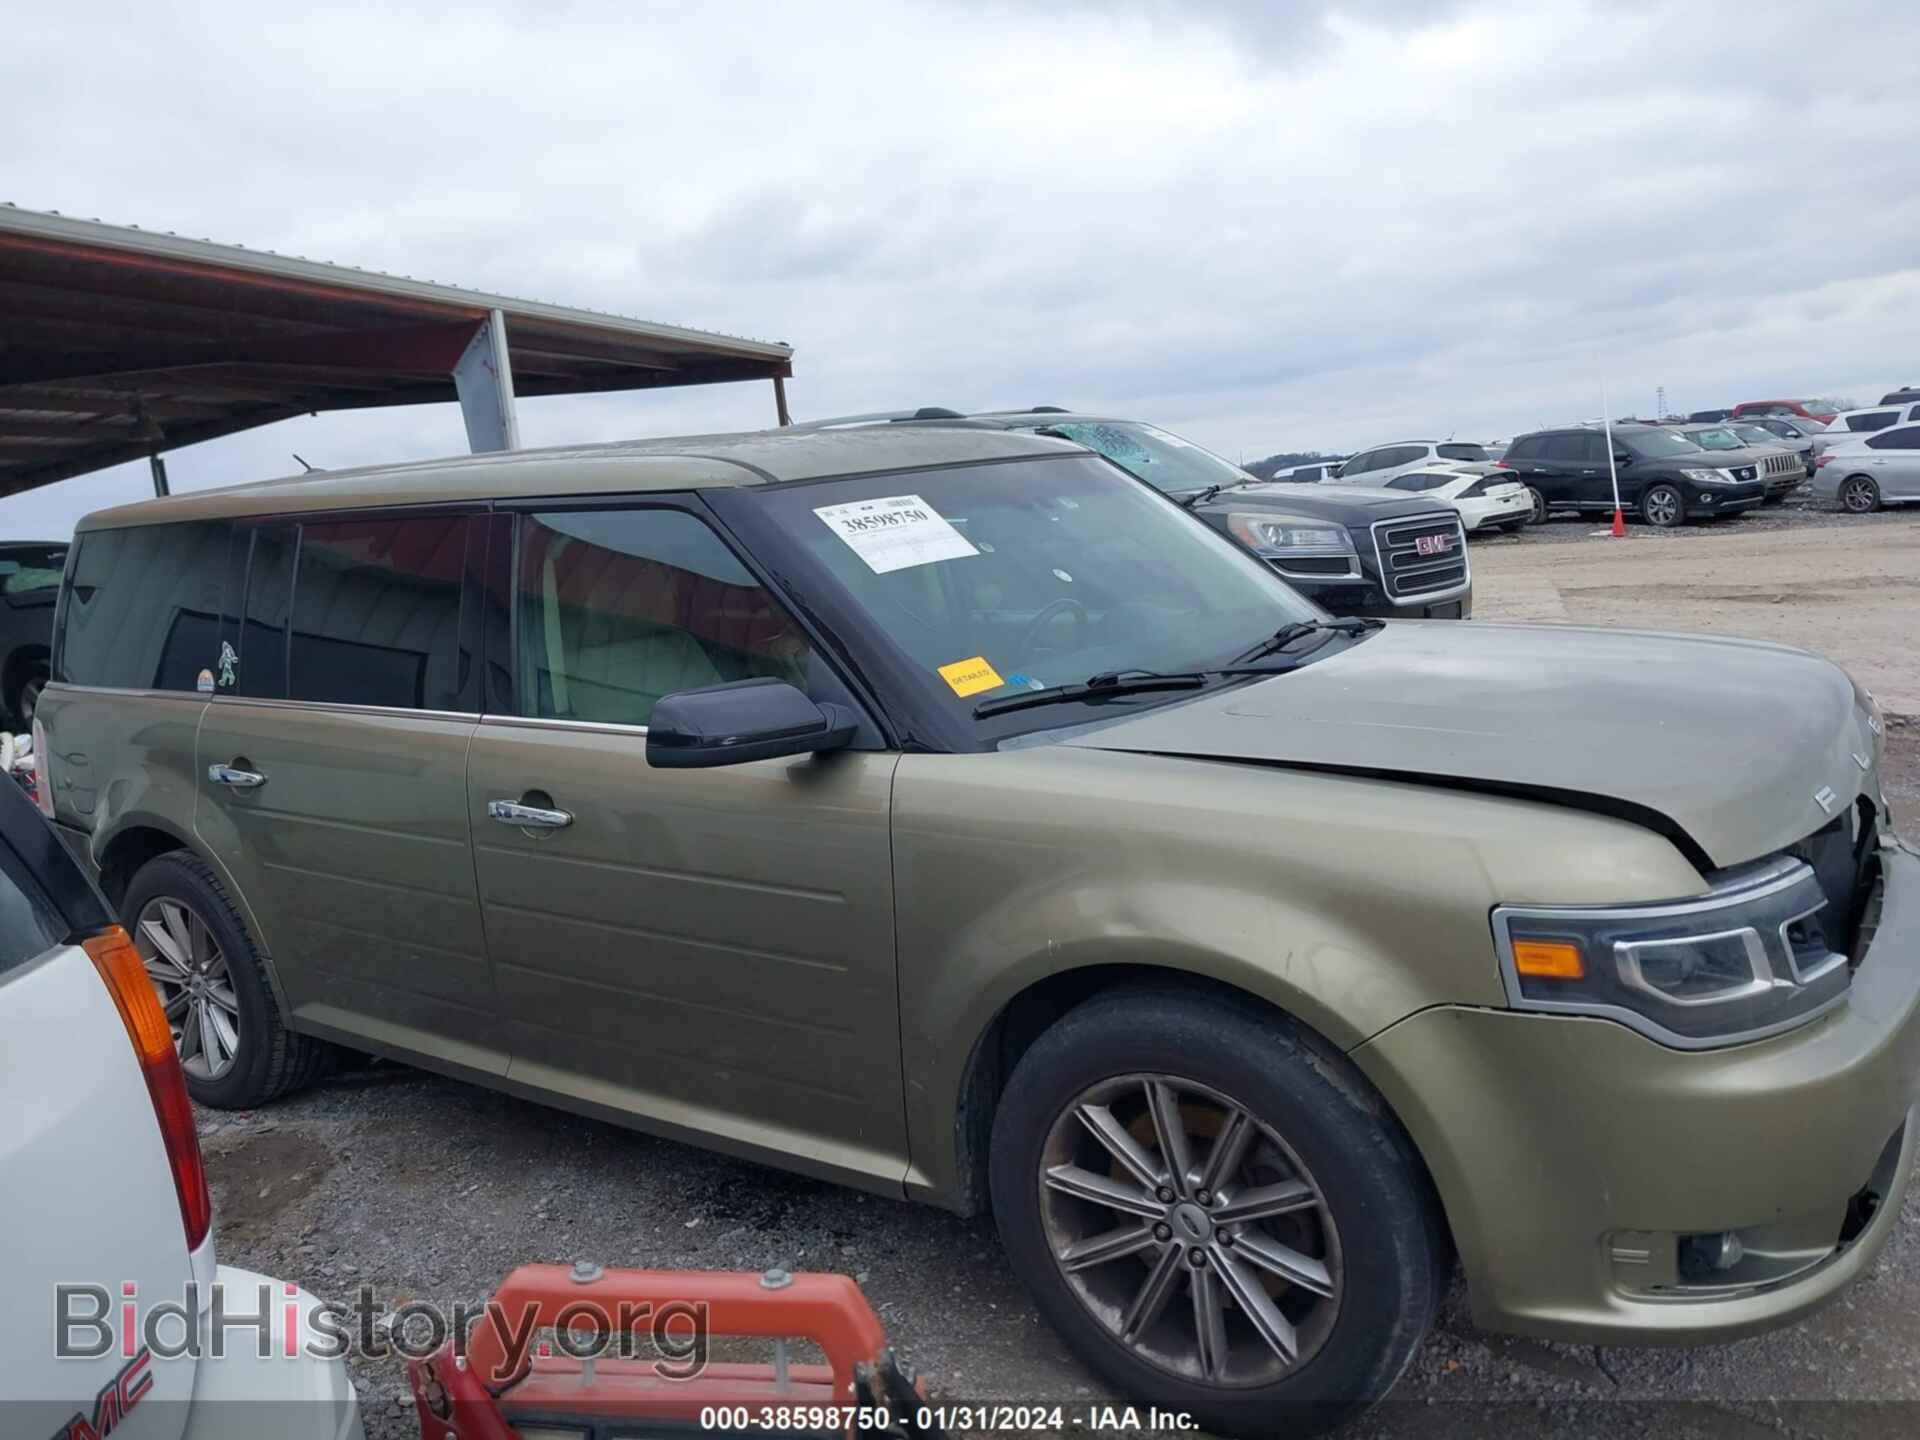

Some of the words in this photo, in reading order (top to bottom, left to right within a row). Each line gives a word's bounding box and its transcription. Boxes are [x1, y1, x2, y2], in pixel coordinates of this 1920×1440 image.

[841, 509, 928, 533] 38598750
[1415, 533, 1454, 556] GMC
[52, 1344, 155, 1440] MC
